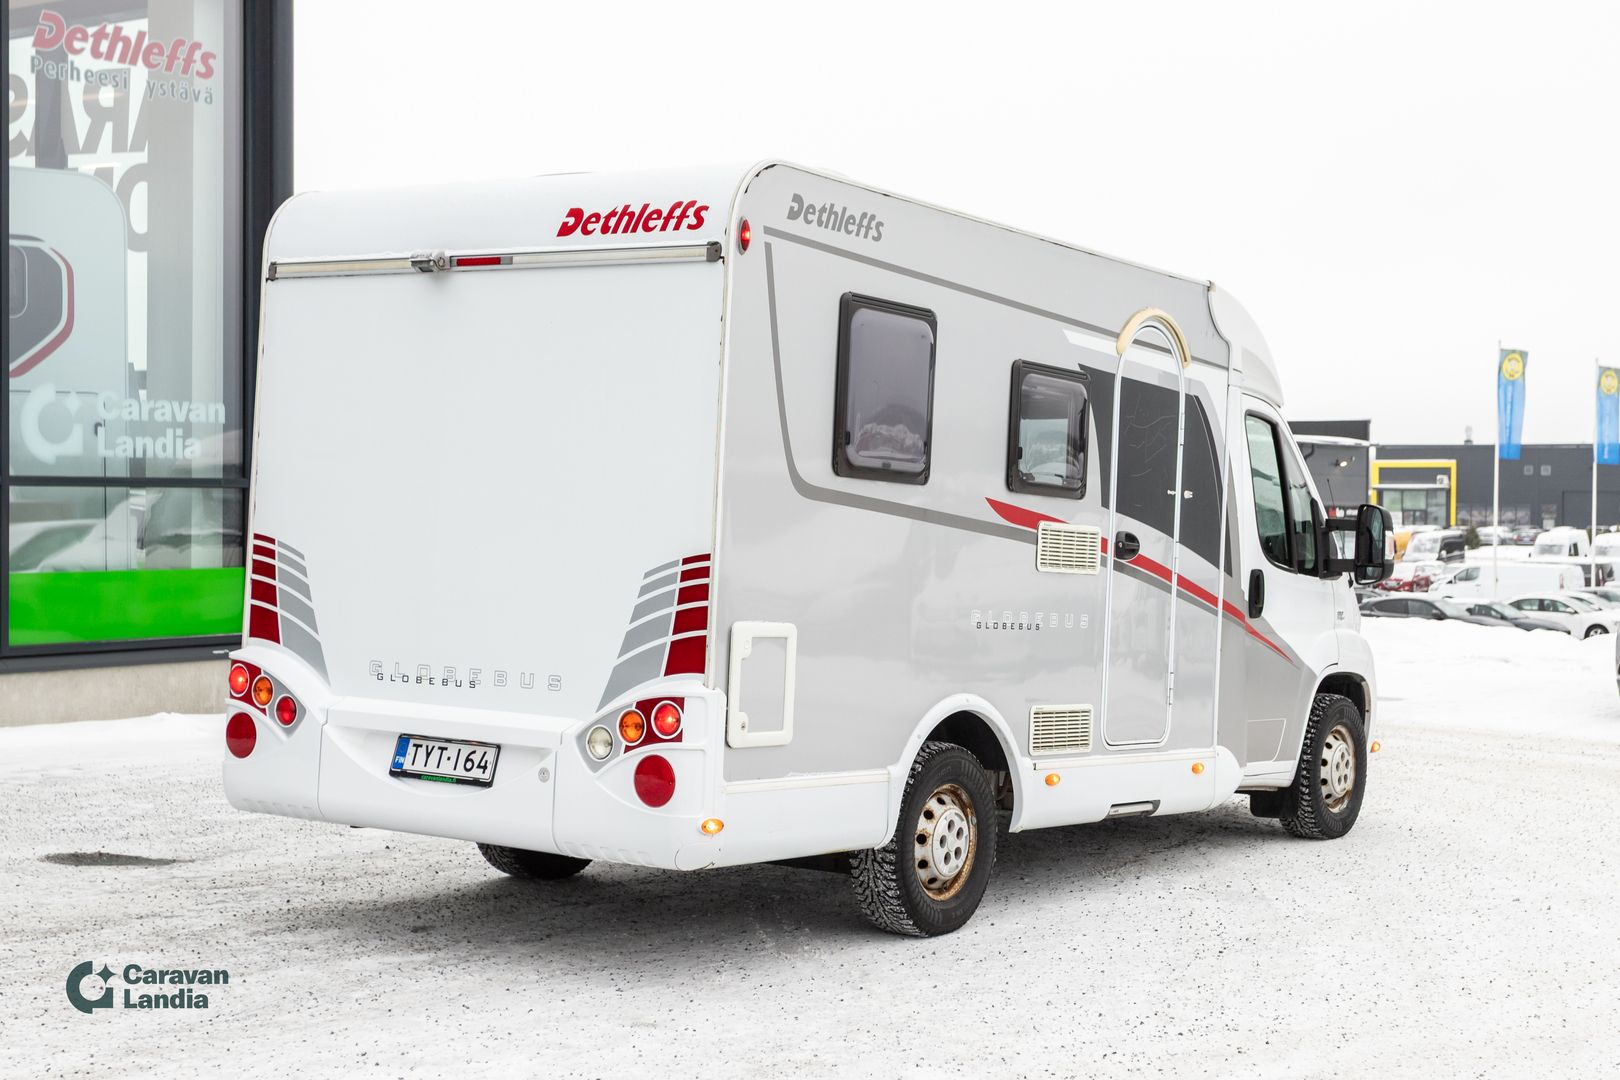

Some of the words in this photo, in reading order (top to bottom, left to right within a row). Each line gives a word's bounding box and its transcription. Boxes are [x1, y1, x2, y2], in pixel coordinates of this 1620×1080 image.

[31, 9, 217, 80] Dethleffs
[30, 55, 129, 91] Perheesi
[146, 79, 214, 105] ystävä
[556, 199, 710, 238] Dethleffs
[786, 192, 885, 242] Dethleffs
[96, 389, 226, 424] Caravan
[97, 427, 202, 459] Landia
[976, 621, 1041, 631] GLOBEBUS
[376, 672, 476, 689] GLOBEBUS
